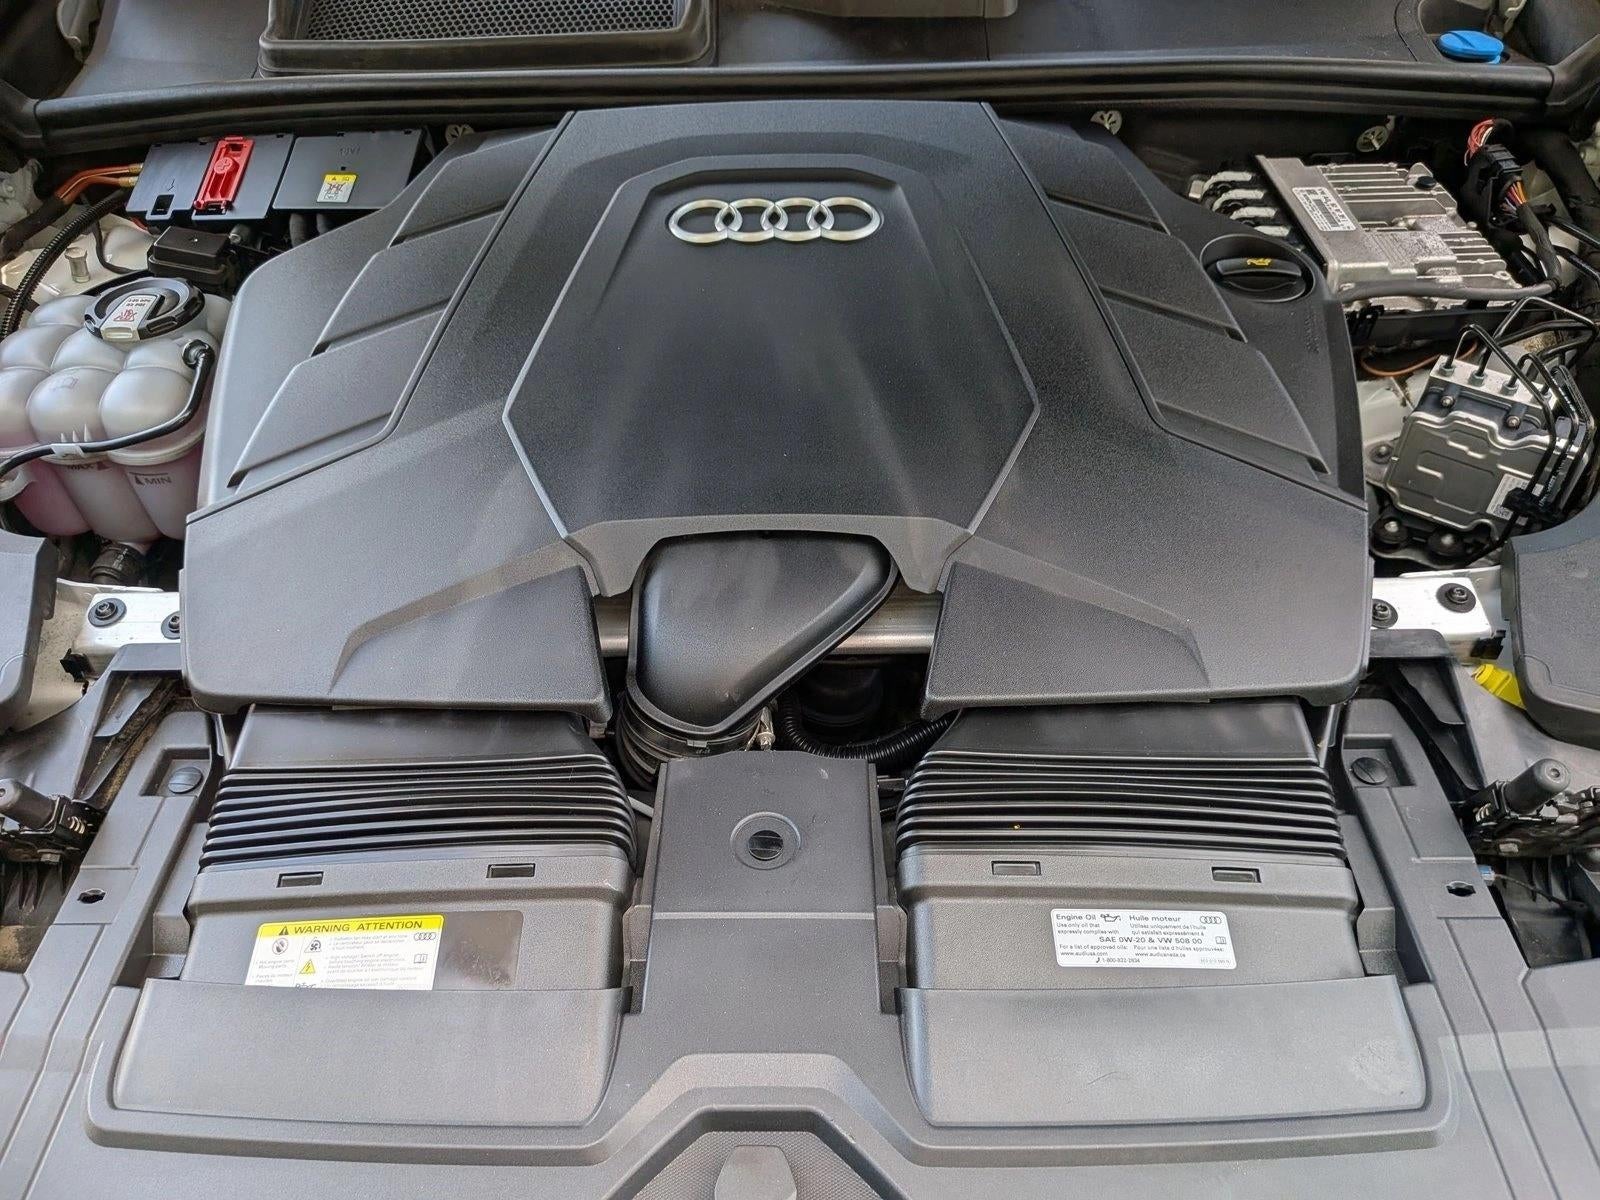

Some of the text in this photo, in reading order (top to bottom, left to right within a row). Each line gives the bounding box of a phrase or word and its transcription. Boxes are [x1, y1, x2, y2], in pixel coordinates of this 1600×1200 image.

[145, 476, 172, 485] MIN
[294, 920, 423, 934] WARNING ATTENTION
